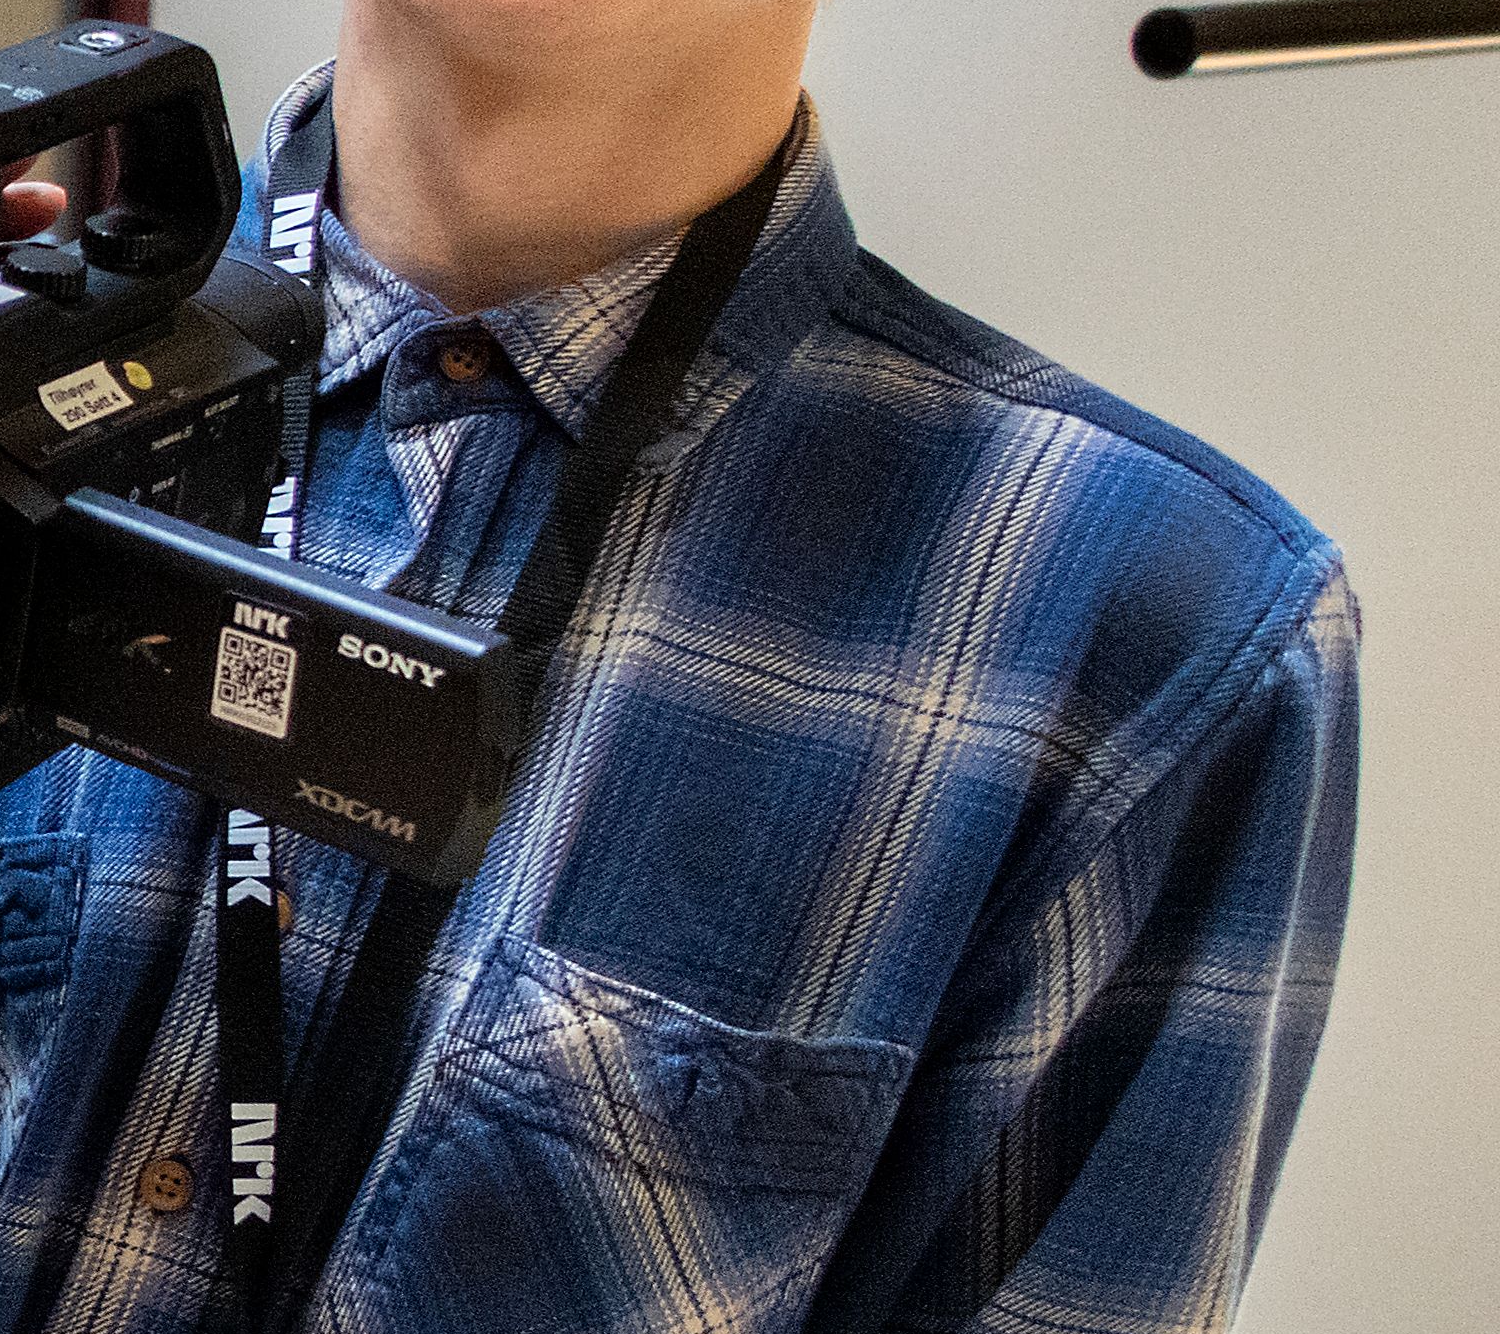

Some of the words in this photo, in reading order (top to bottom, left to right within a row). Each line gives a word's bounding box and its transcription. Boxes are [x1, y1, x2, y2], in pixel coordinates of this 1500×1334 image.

[233, 601, 292, 639] NRK
[337, 633, 446, 688] SONY
[296, 779, 417, 843] XDCAM
[230, 1103, 277, 1225] NRK
